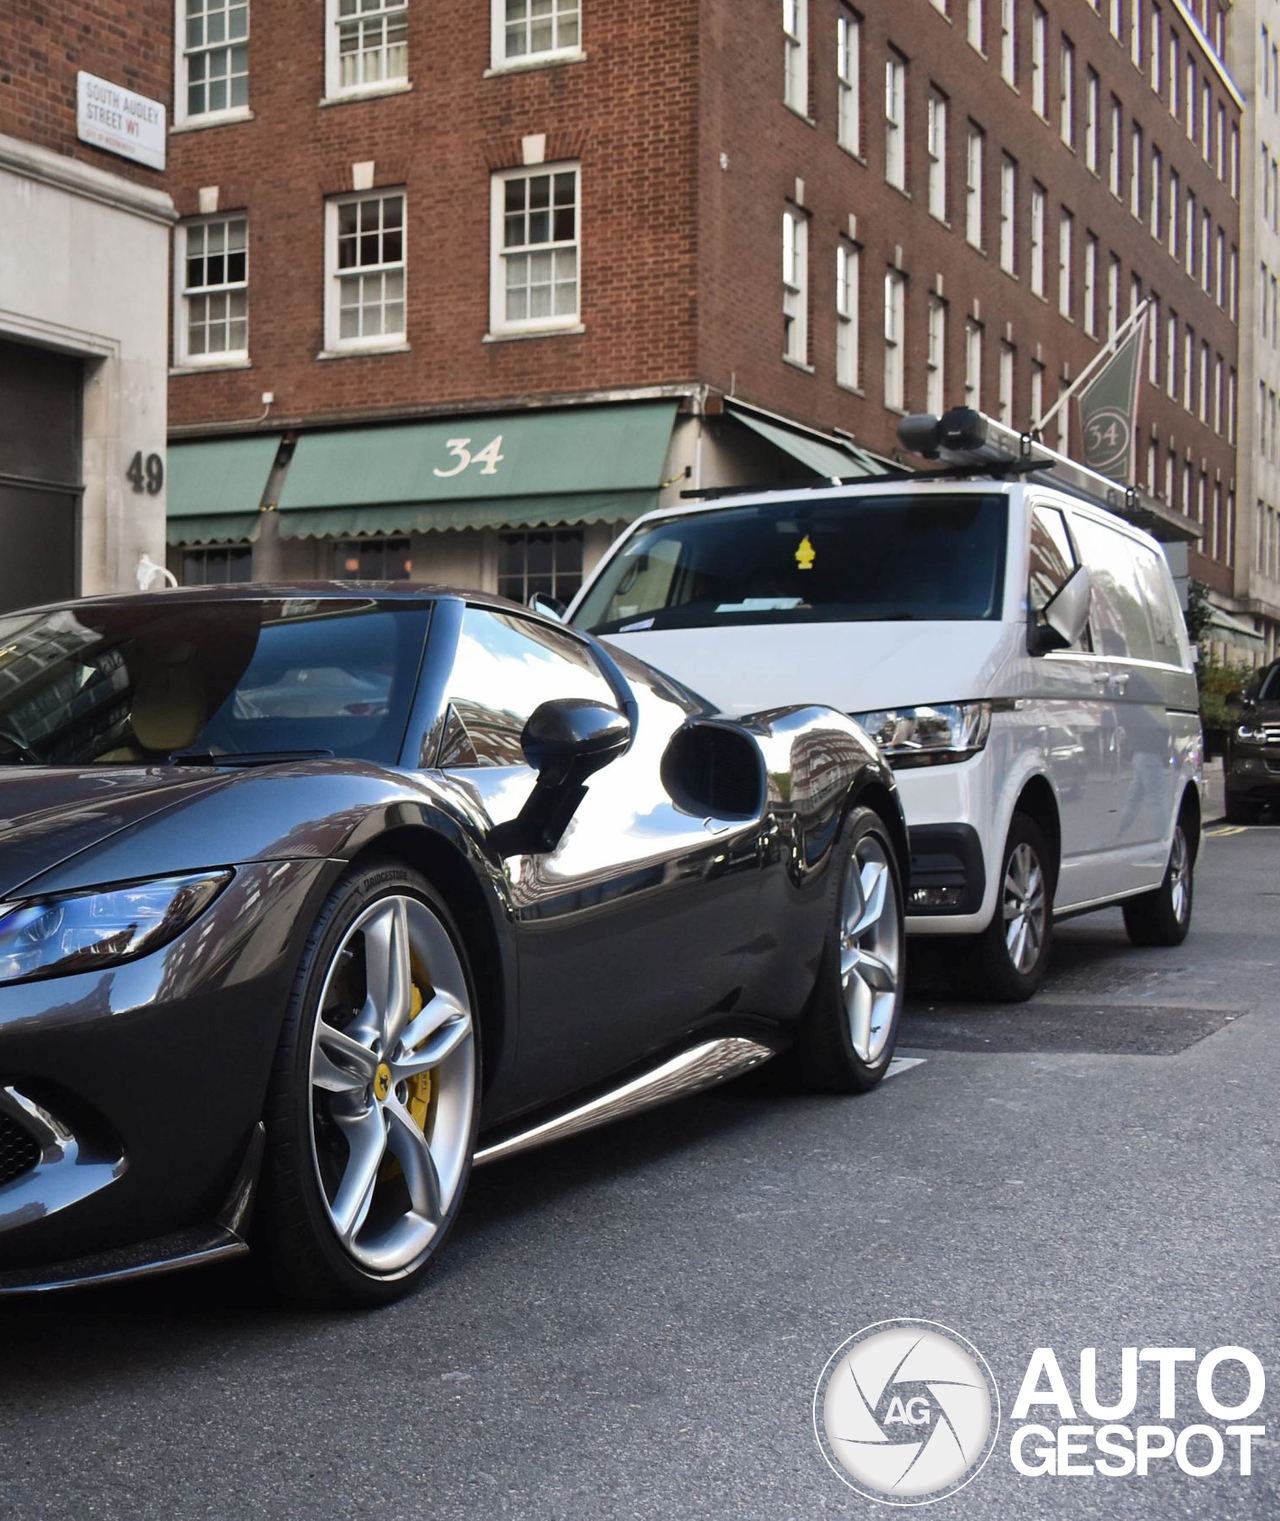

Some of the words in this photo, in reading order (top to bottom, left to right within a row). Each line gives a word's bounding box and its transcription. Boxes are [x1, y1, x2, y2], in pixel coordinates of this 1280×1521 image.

[86, 81, 120, 109] SOUTH
[123, 97, 159, 125] AUDLEY
[86, 102, 122, 130] STREET
[126, 118, 139, 137] W1
[433, 434, 504, 477] 34
[1087, 421, 1118, 451] 34
[125, 450, 163, 497] 49
